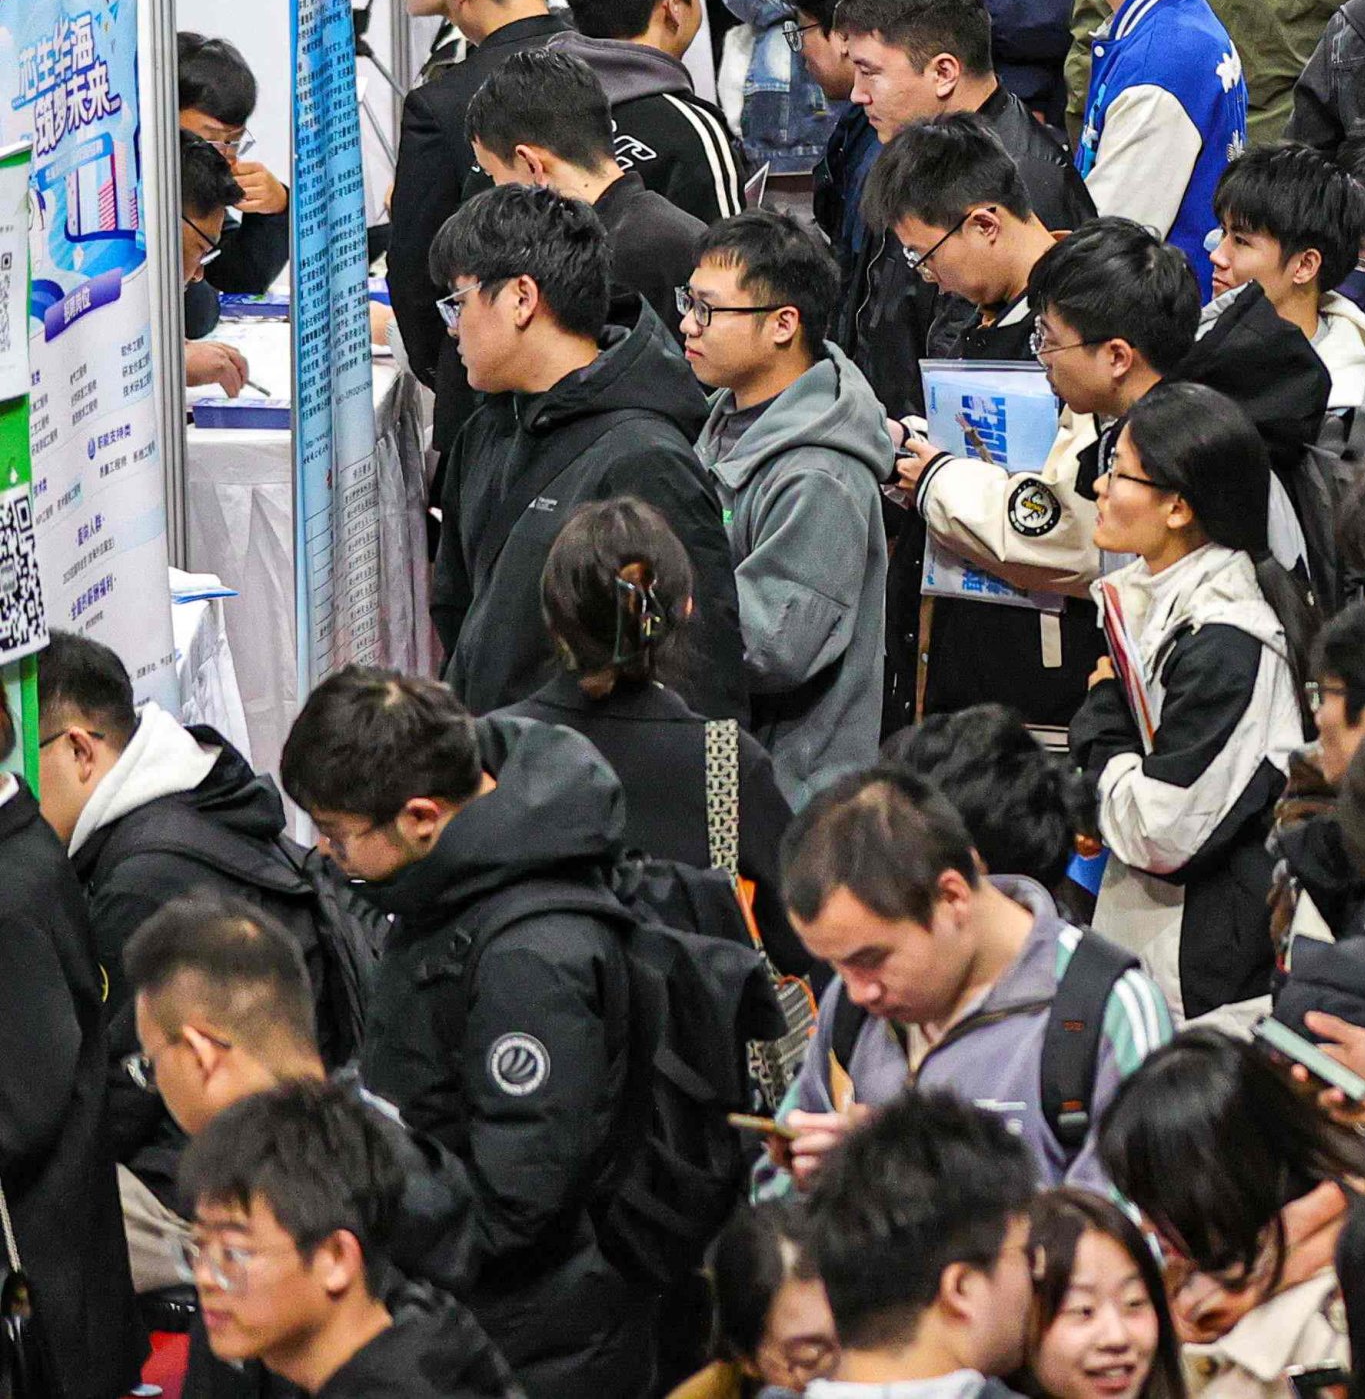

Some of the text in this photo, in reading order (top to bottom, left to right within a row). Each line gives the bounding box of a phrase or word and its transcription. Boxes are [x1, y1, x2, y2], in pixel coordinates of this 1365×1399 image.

[18, 11, 95, 101] 芯生华海
[35, 61, 115, 157] 筑梦未来
